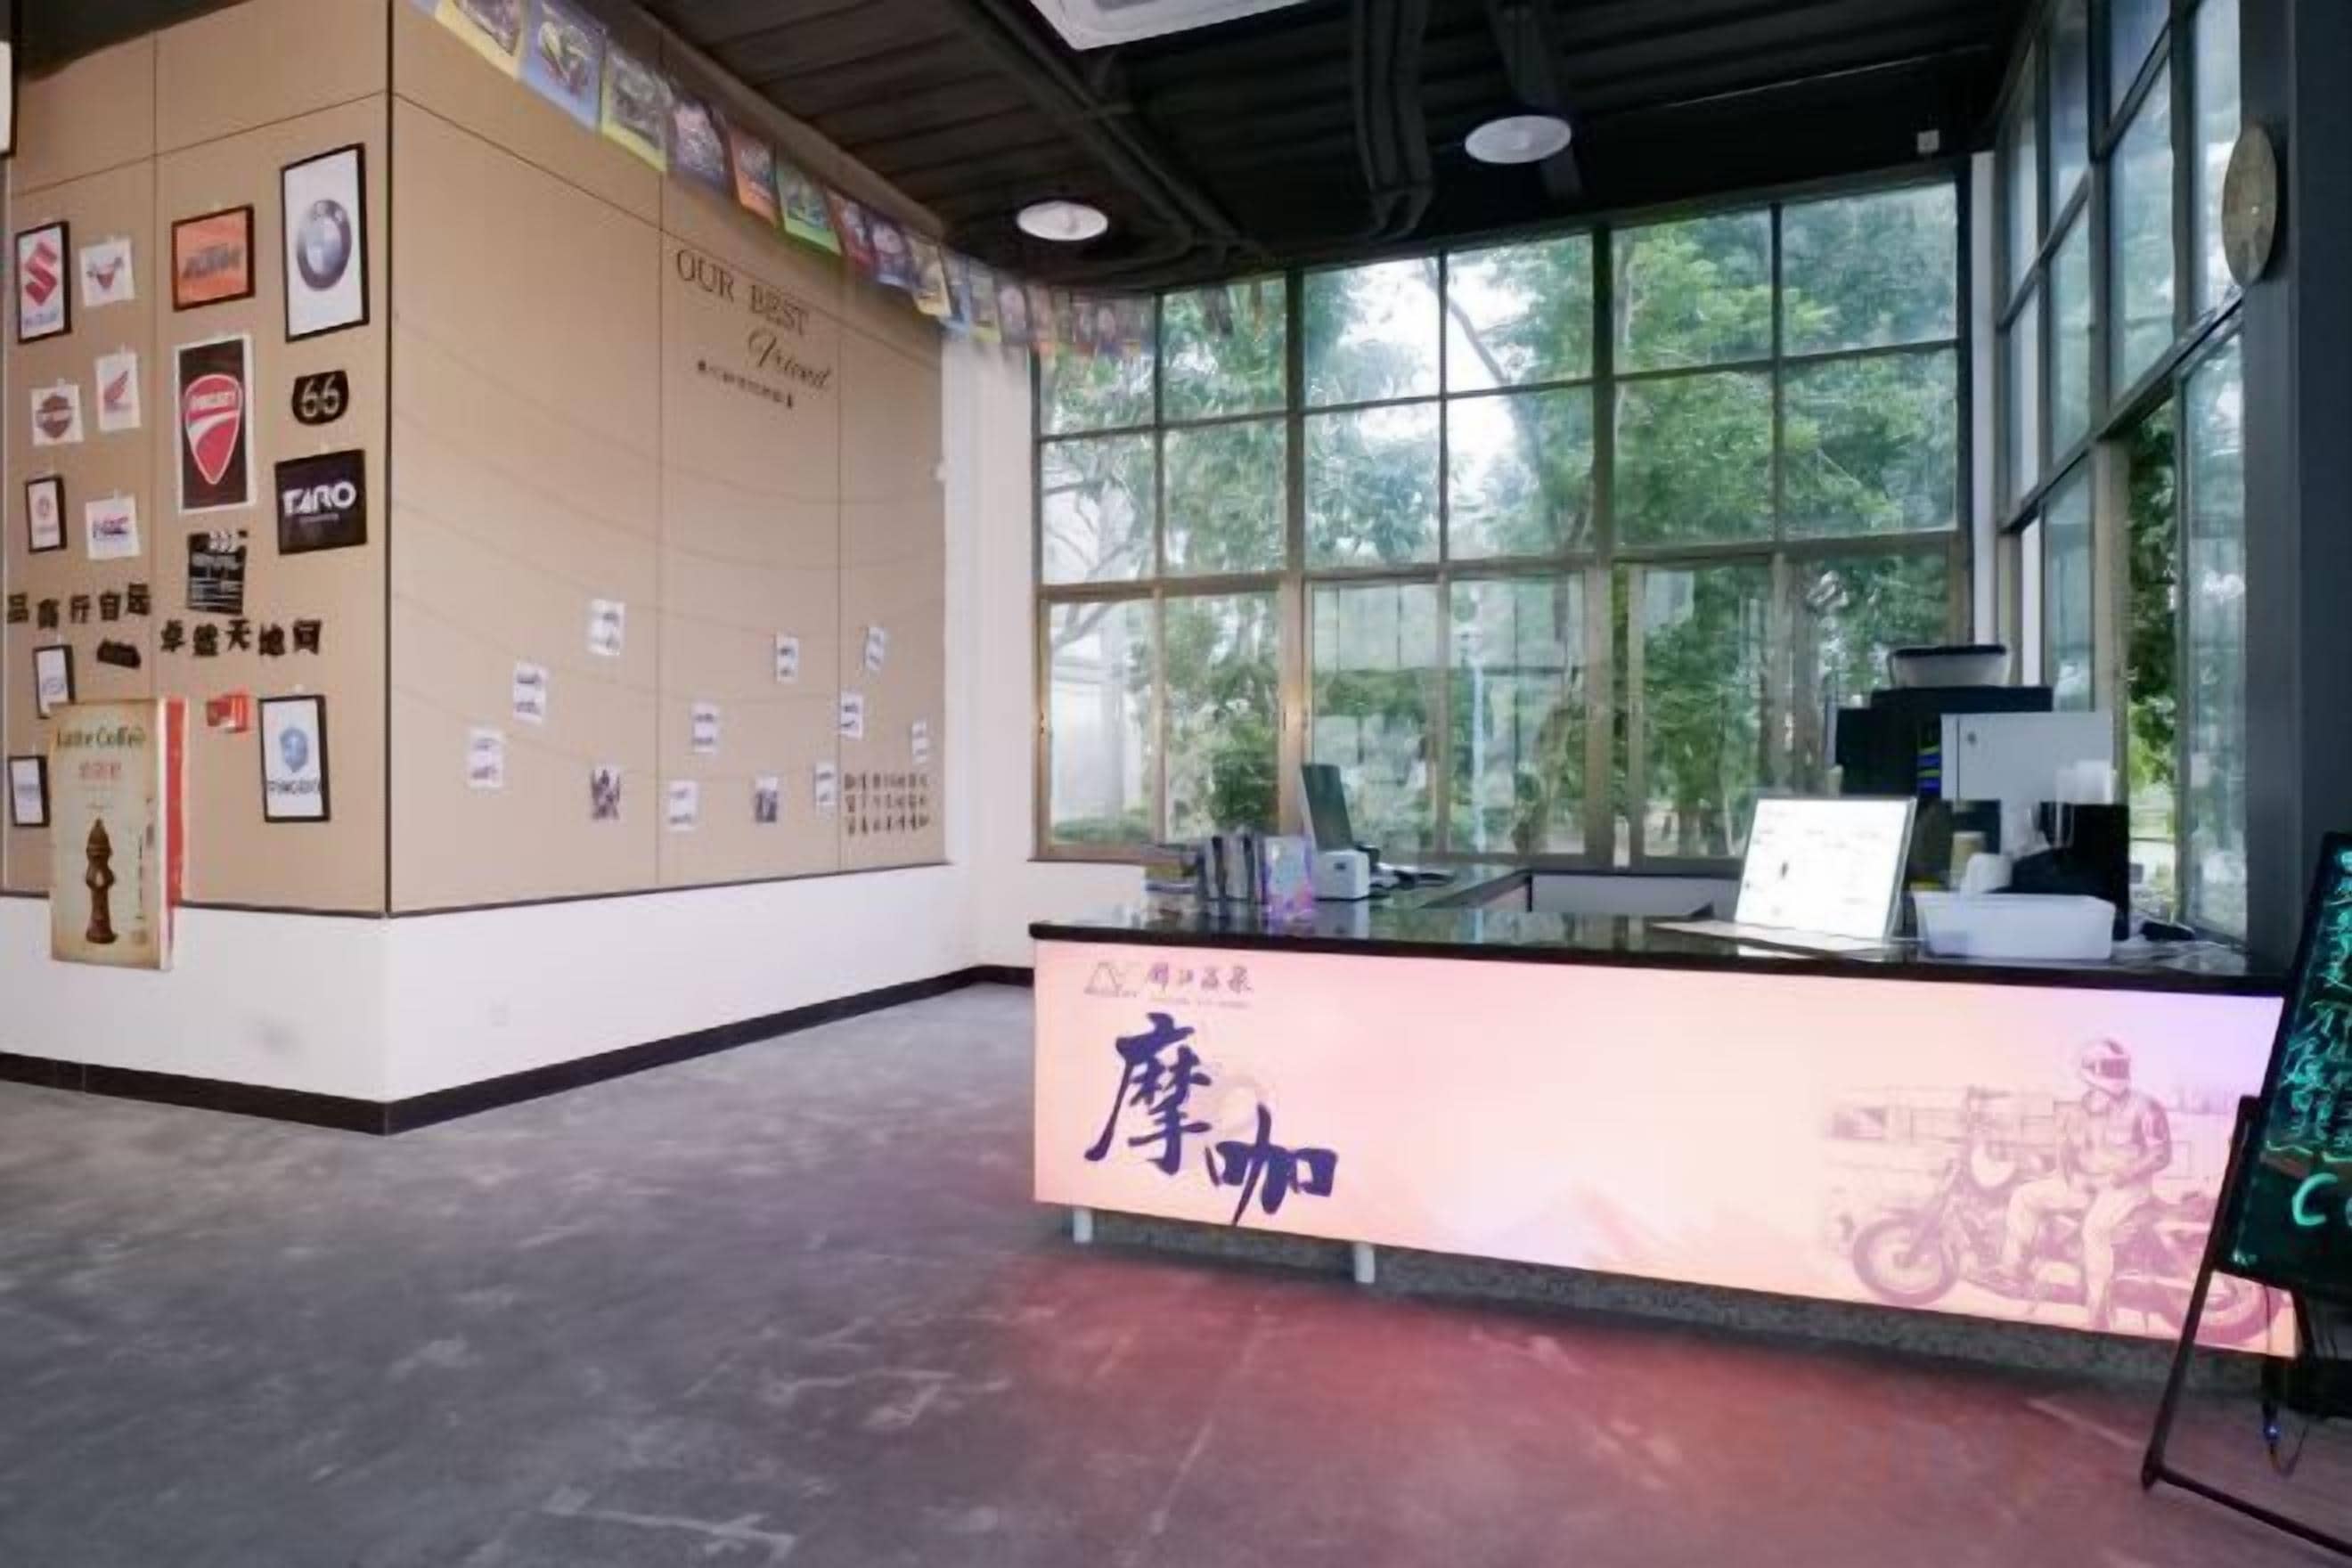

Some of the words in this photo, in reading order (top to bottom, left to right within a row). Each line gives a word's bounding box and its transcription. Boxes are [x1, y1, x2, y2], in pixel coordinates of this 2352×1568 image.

[676, 249, 735, 303] OUR
[749, 284, 810, 337] BEST
[300, 374, 340, 419] 66
[1084, 1012, 1339, 1227] 摩咖
